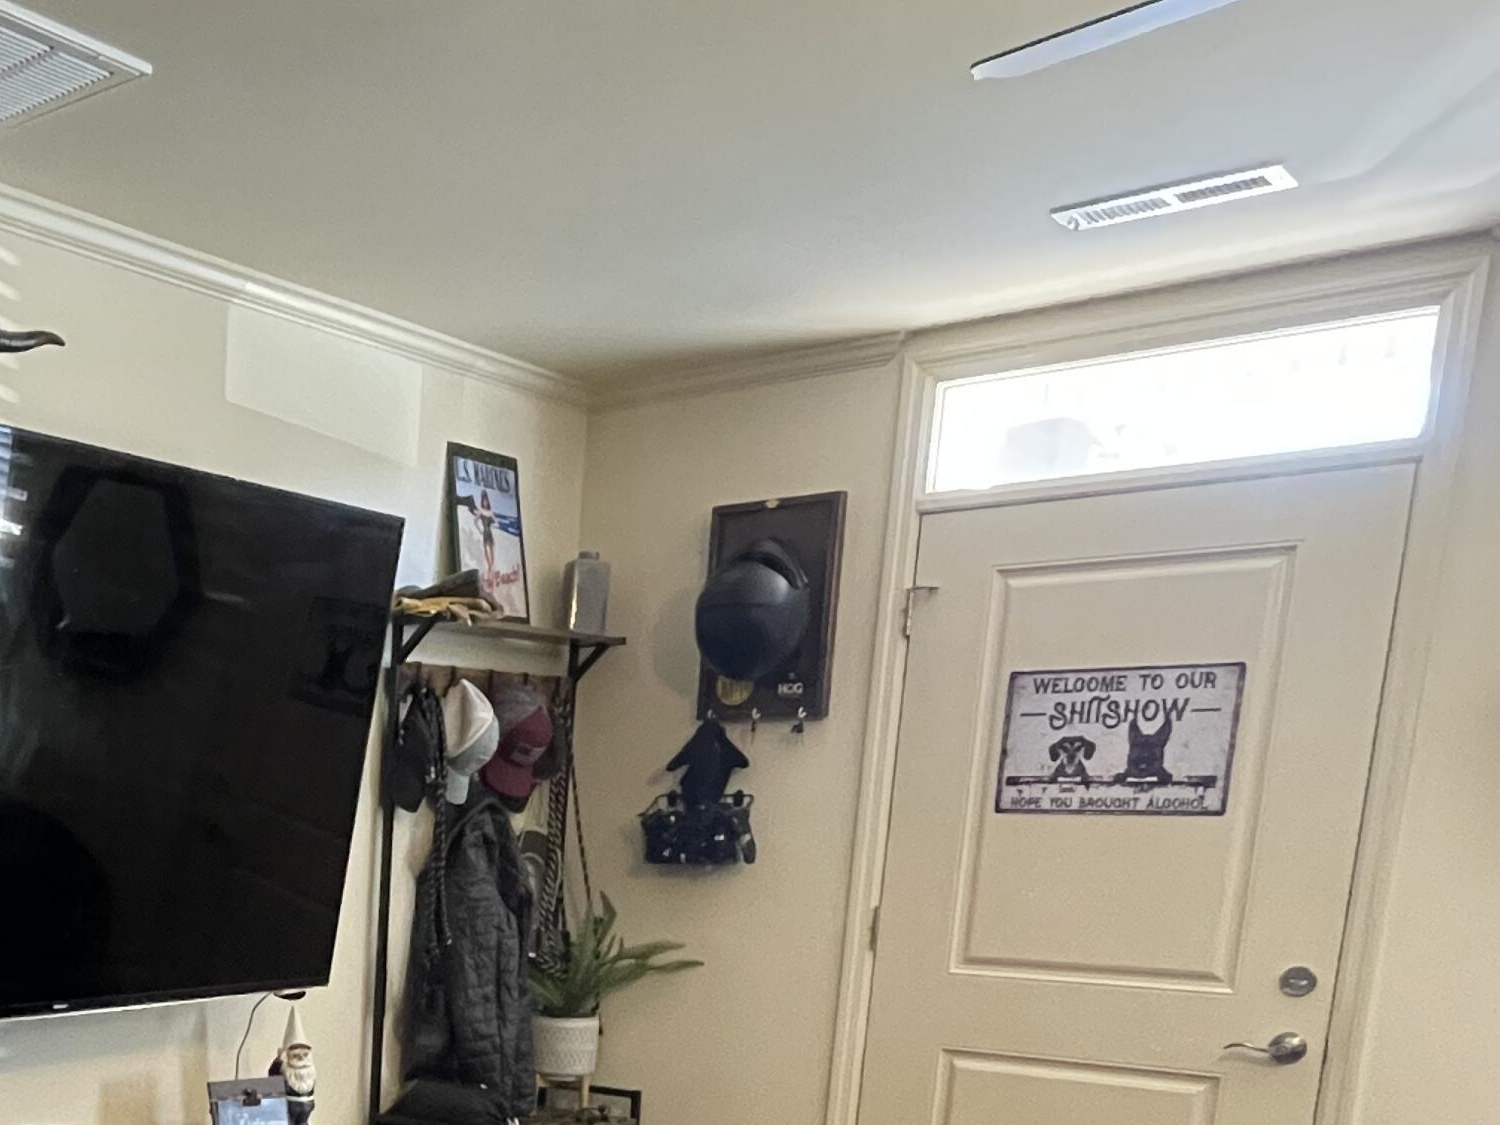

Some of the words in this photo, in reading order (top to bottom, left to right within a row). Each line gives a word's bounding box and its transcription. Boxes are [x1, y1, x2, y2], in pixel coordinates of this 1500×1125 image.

[1033, 674, 1128, 694] WELCOME
[1139, 673, 1164, 691] TO
[1176, 671, 1218, 690] OUR
[1049, 694, 1191, 730] SHITSHOW
[1010, 796, 1042, 809] HOPE
[1050, 797, 1073, 809] YOU
[1079, 796, 1141, 809] BROUGHT
[1146, 795, 1208, 810] ALCOHOL
